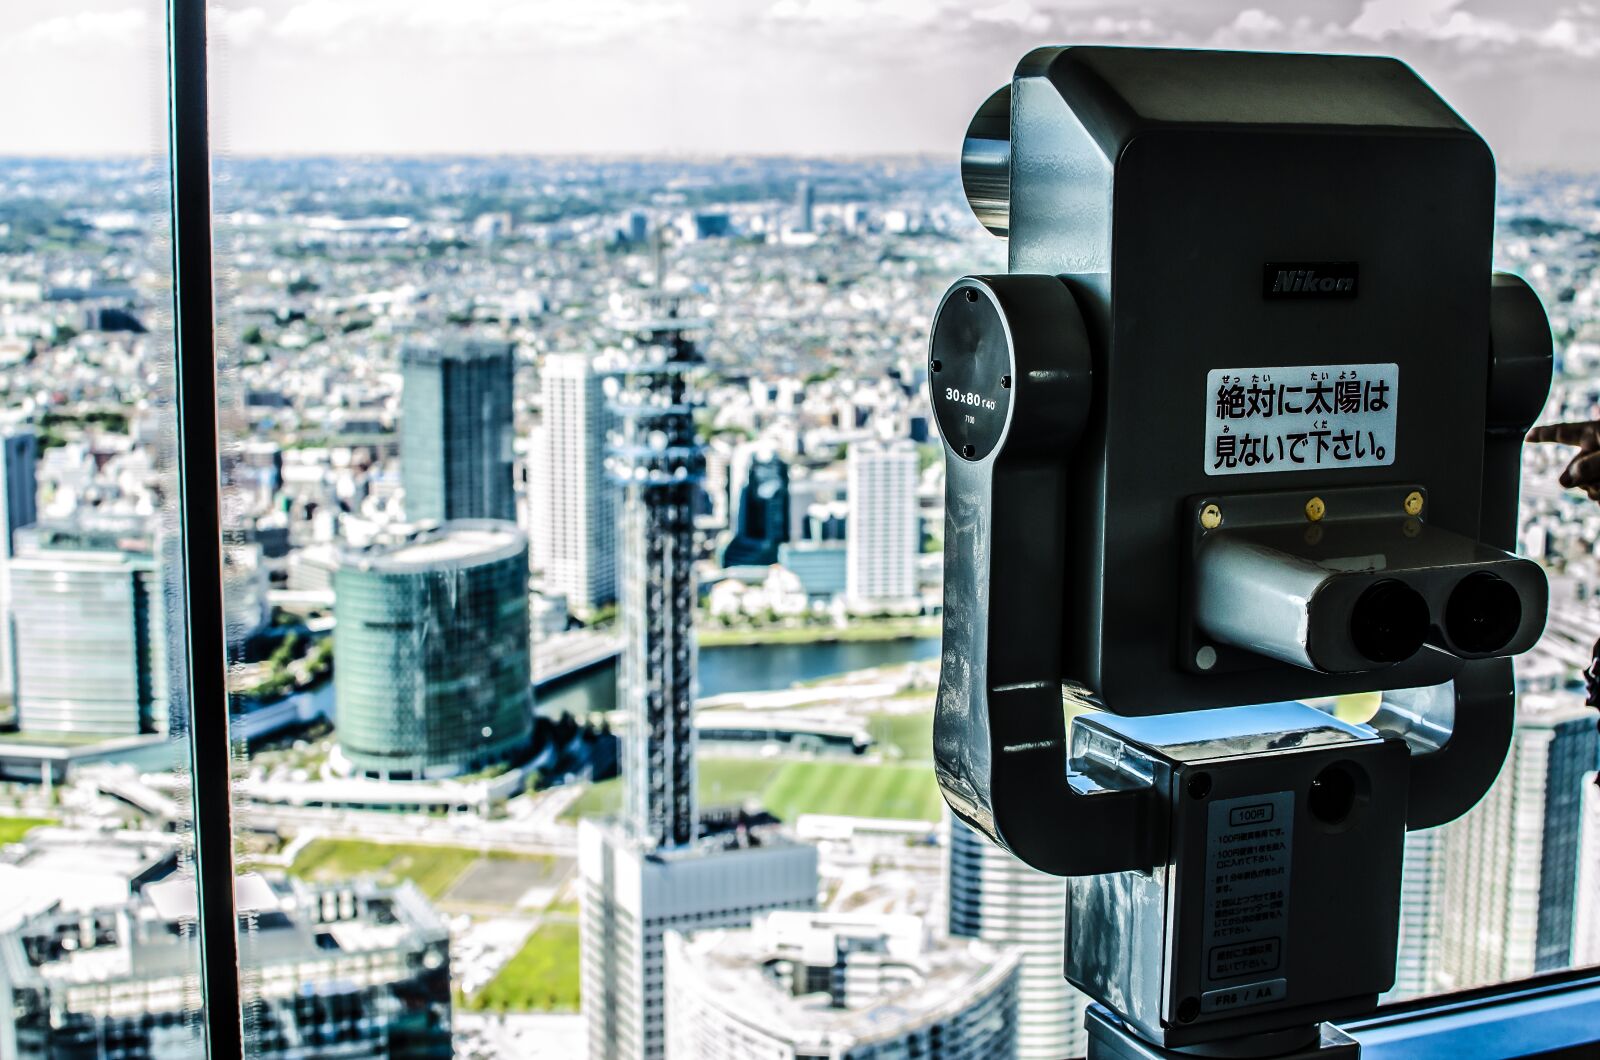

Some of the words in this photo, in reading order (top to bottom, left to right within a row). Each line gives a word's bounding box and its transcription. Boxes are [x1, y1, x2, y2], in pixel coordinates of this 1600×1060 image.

[1272, 270, 1354, 293] Nikon
[1216, 380, 1389, 419] 絶対に太陽は
[1214, 430, 1386, 469] 見ないで下さい。
[1239, 808, 1265, 821] 100円
[1255, 987, 1272, 999] AA
